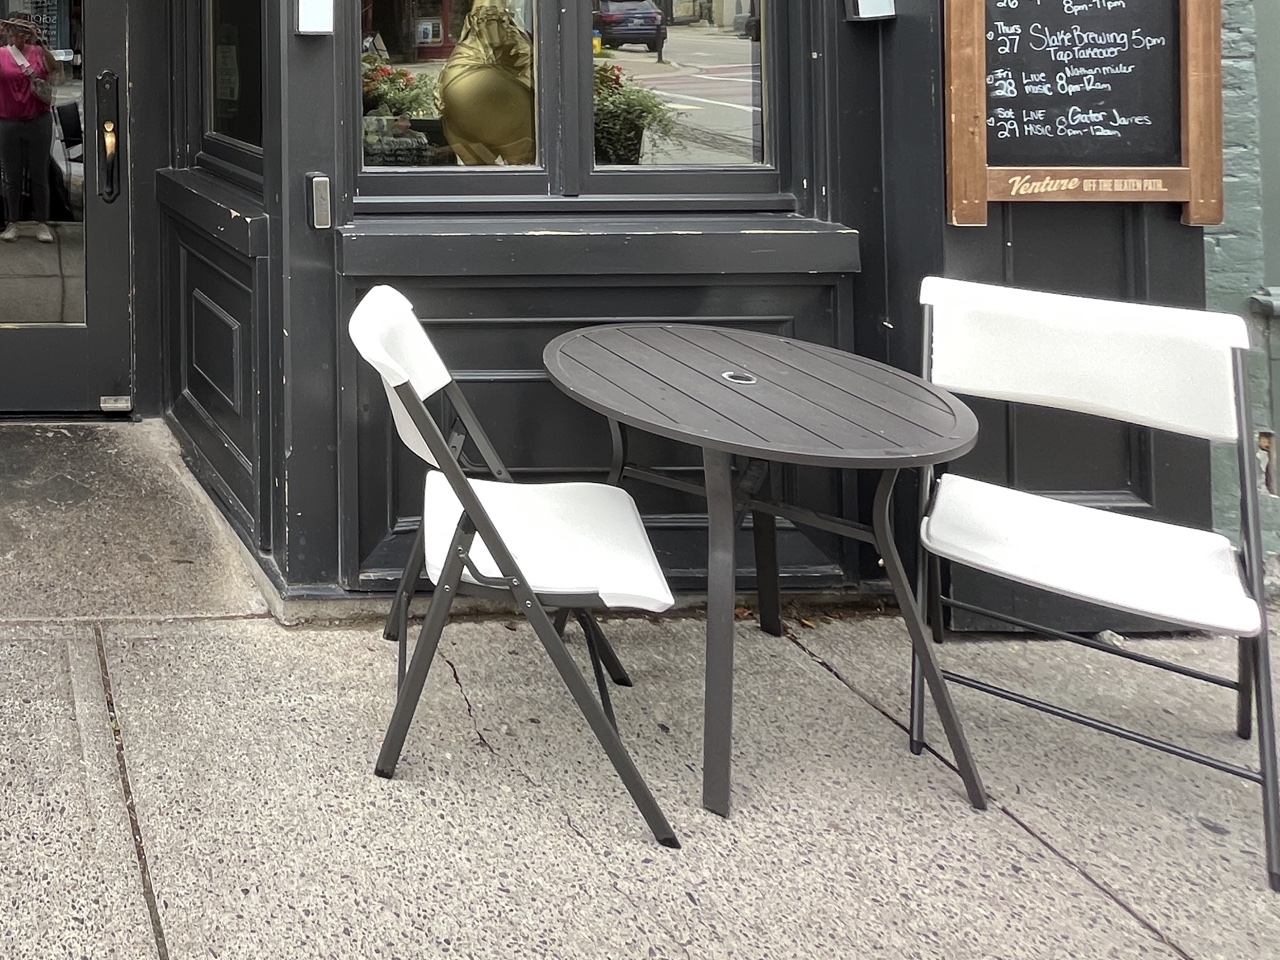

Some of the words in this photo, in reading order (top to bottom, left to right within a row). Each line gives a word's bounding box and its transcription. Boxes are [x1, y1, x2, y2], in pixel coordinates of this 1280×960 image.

[994, 21, 1021, 35] Thurs
[997, 35, 1020, 54] 27
[1071, 25, 1129, 51] Brewing
[1131, 28, 1166, 50] 5pm
[1045, 47, 1072, 64] Tap
[1073, 46, 1122, 59] Takeover
[993, 68, 1012, 79] Fri
[995, 79, 1018, 97] 28
[997, 107, 1015, 119] Sat
[1068, 106, 1107, 126] Gator
[1109, 109, 1152, 126] James
[997, 120, 1019, 138] 29
[1008, 175, 1081, 195] Venture
[1082, 179, 1097, 192] OFF
[1099, 179, 1113, 192] THE
[1114, 179, 1142, 192] BEATEN
